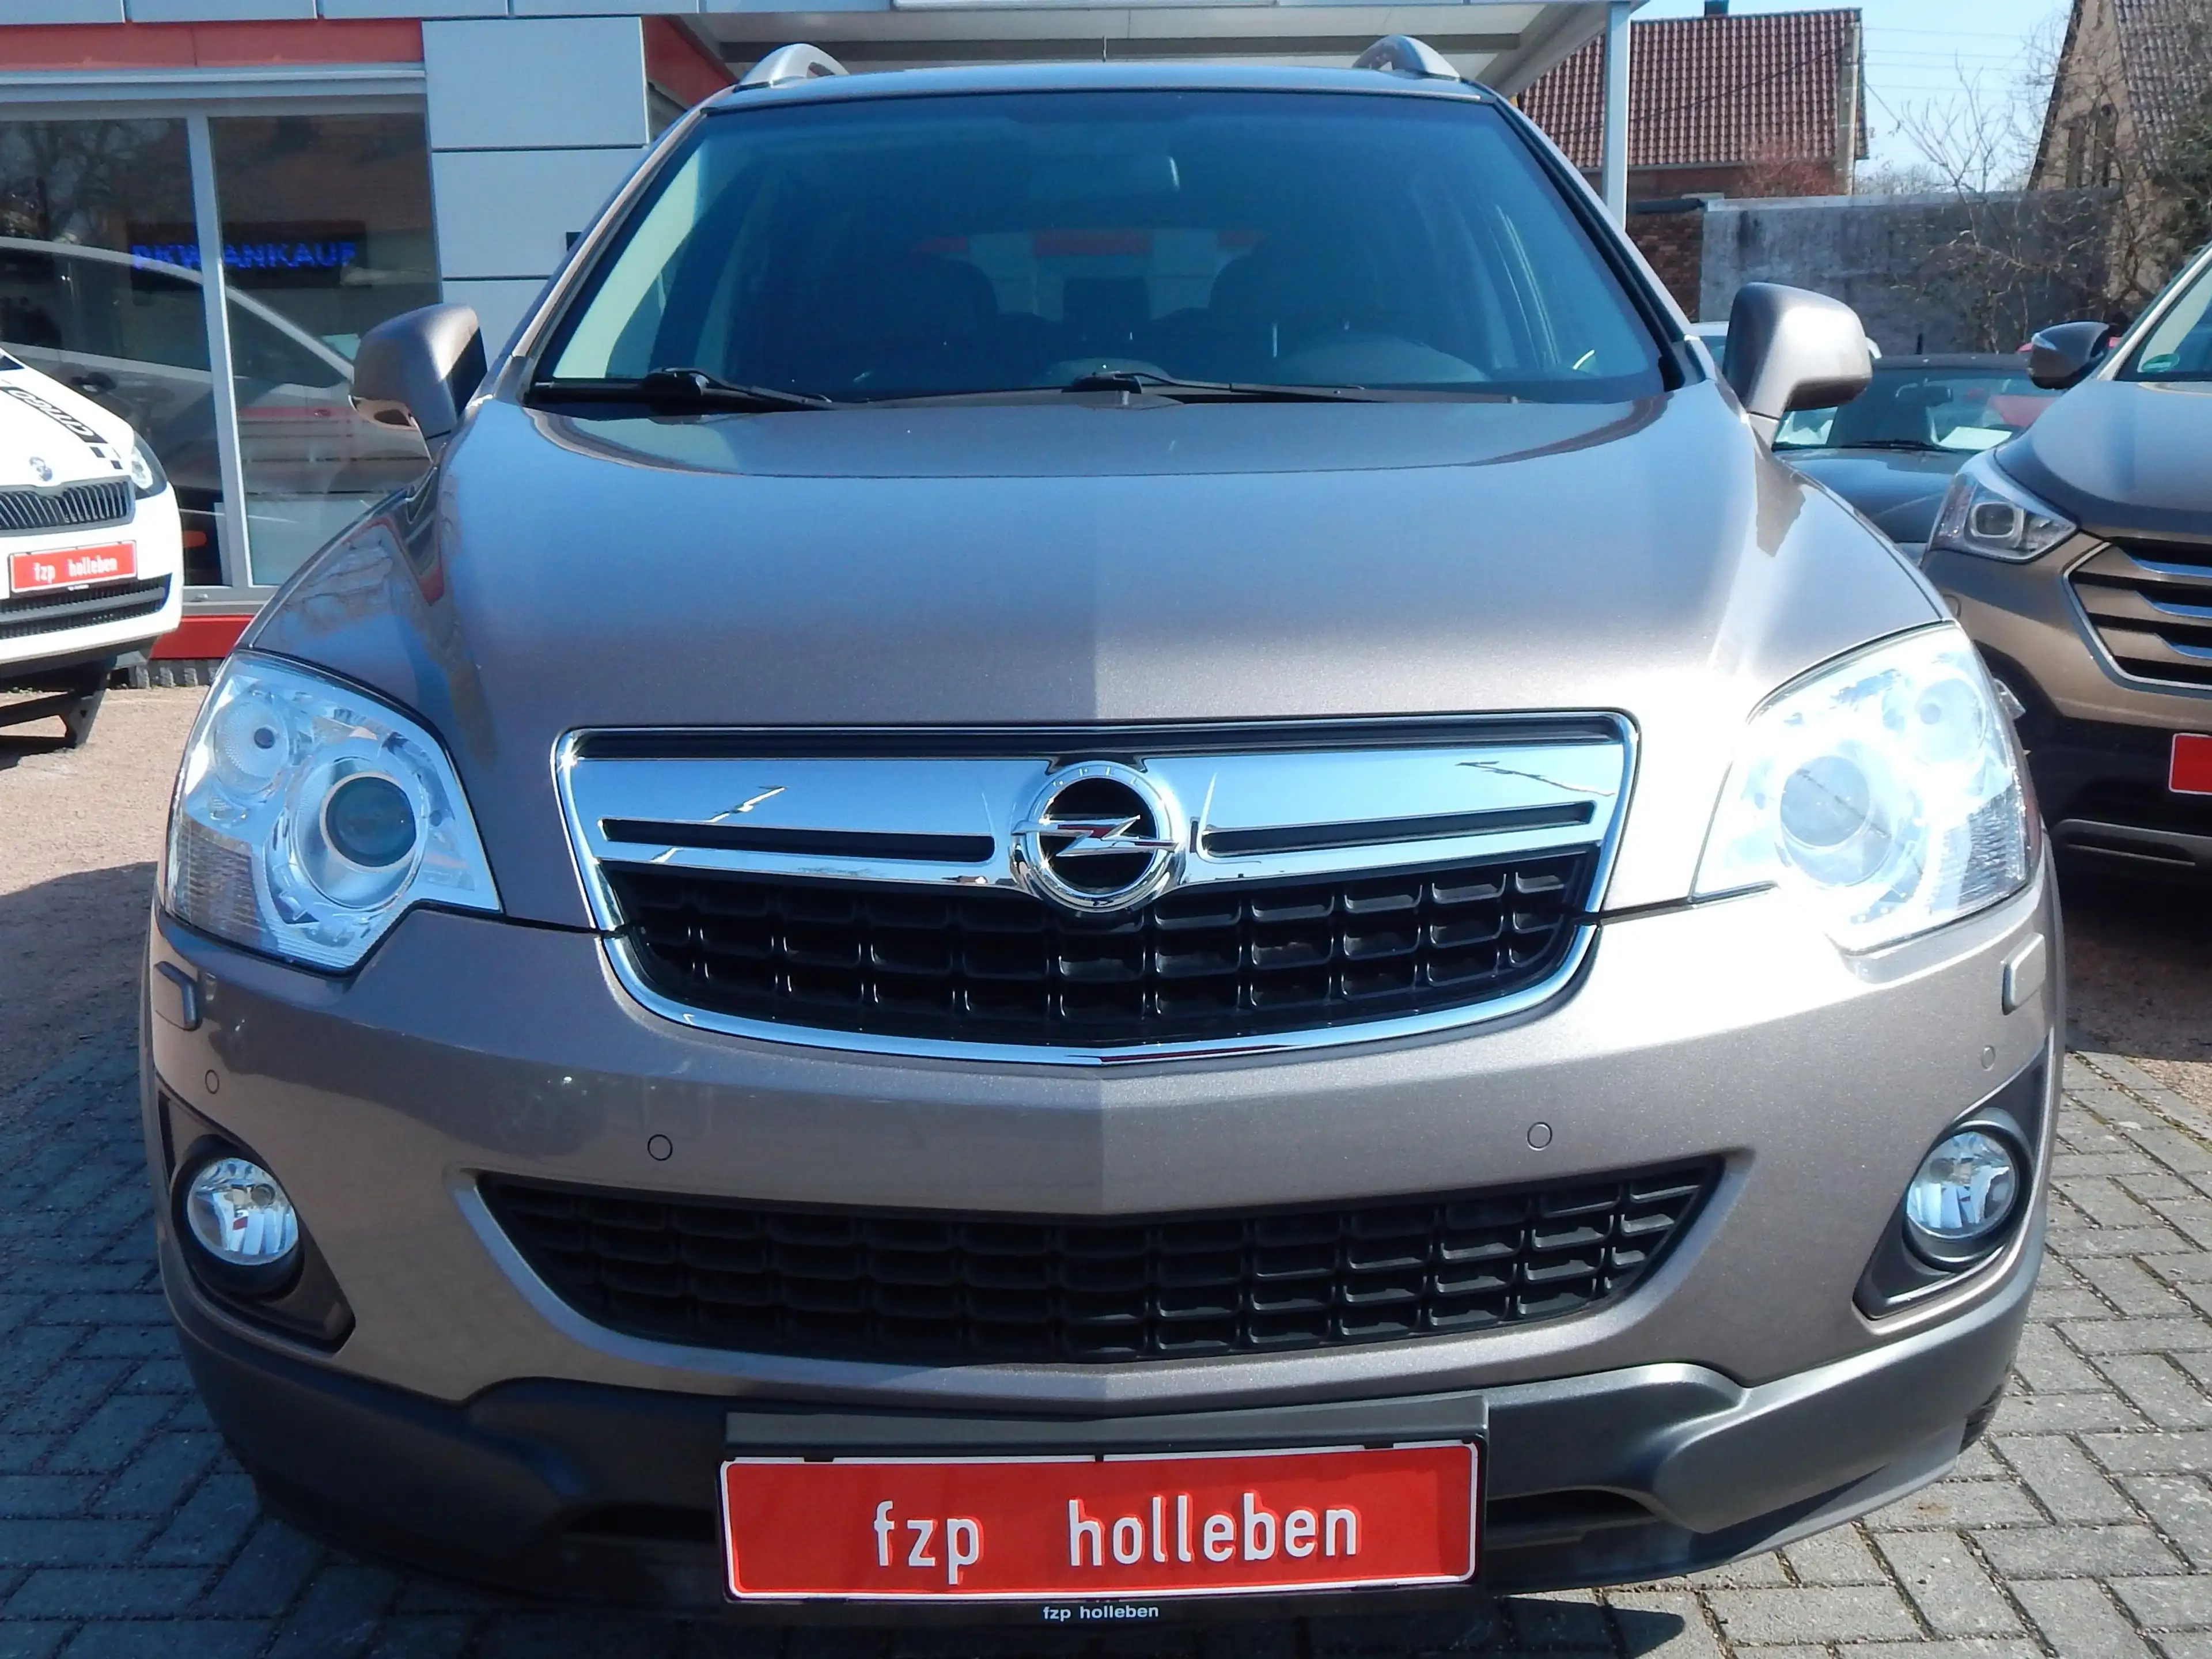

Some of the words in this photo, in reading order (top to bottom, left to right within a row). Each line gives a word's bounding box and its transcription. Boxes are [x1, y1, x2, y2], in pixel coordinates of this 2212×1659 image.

[223, 243, 356, 268] ANKAUF
[67, 555, 118, 577] holleben
[874, 1501, 979, 1585] fzp
[1069, 1493, 1357, 1566] holleben
[1043, 1606, 1071, 1622] fzp
[1080, 1605, 1158, 1619] holleben
